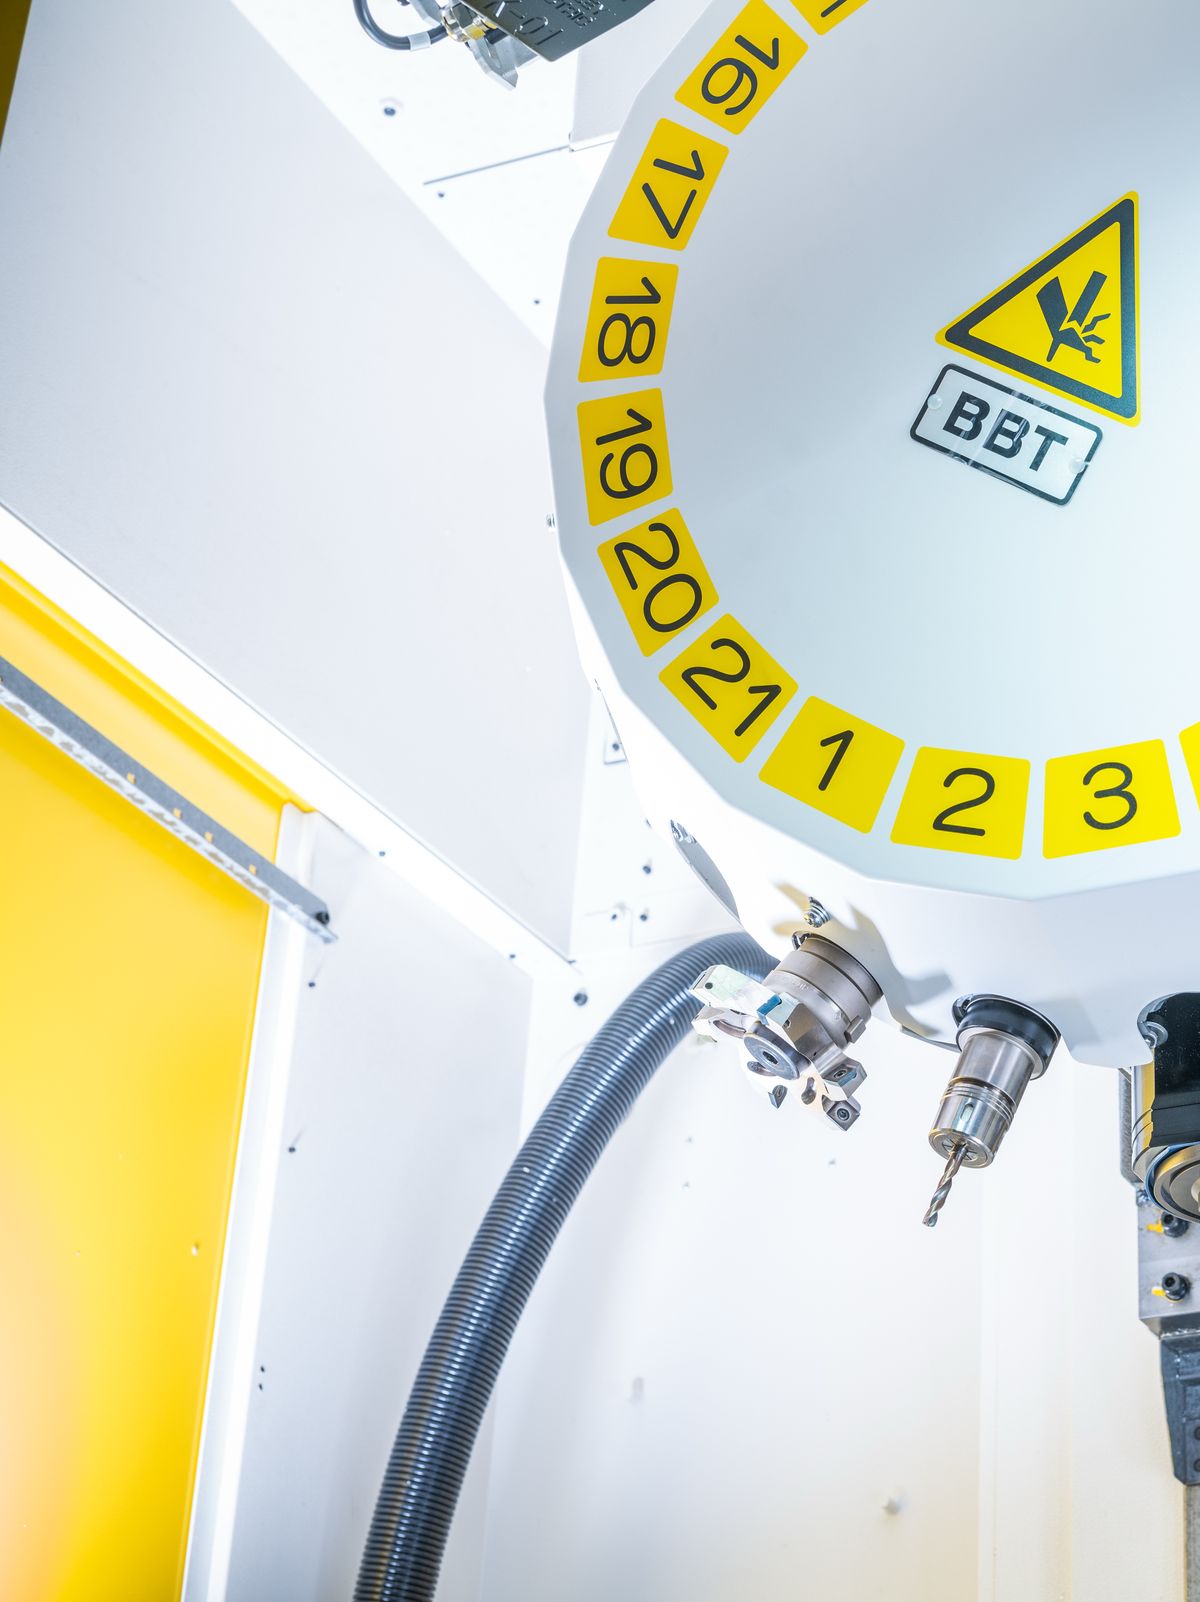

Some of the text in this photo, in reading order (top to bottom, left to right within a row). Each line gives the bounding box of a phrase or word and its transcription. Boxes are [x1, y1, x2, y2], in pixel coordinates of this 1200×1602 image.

[702, 35, 781, 117] 16
[642, 150, 706, 241] 17
[598, 277, 663, 368] 18
[596, 409, 659, 501] 19
[942, 391, 1069, 471] BBT
[614, 523, 704, 634] 20
[682, 639, 783, 738] 21
[819, 731, 856, 792] 1
[933, 768, 997, 838] 2
[1083, 763, 1139, 832] 3
